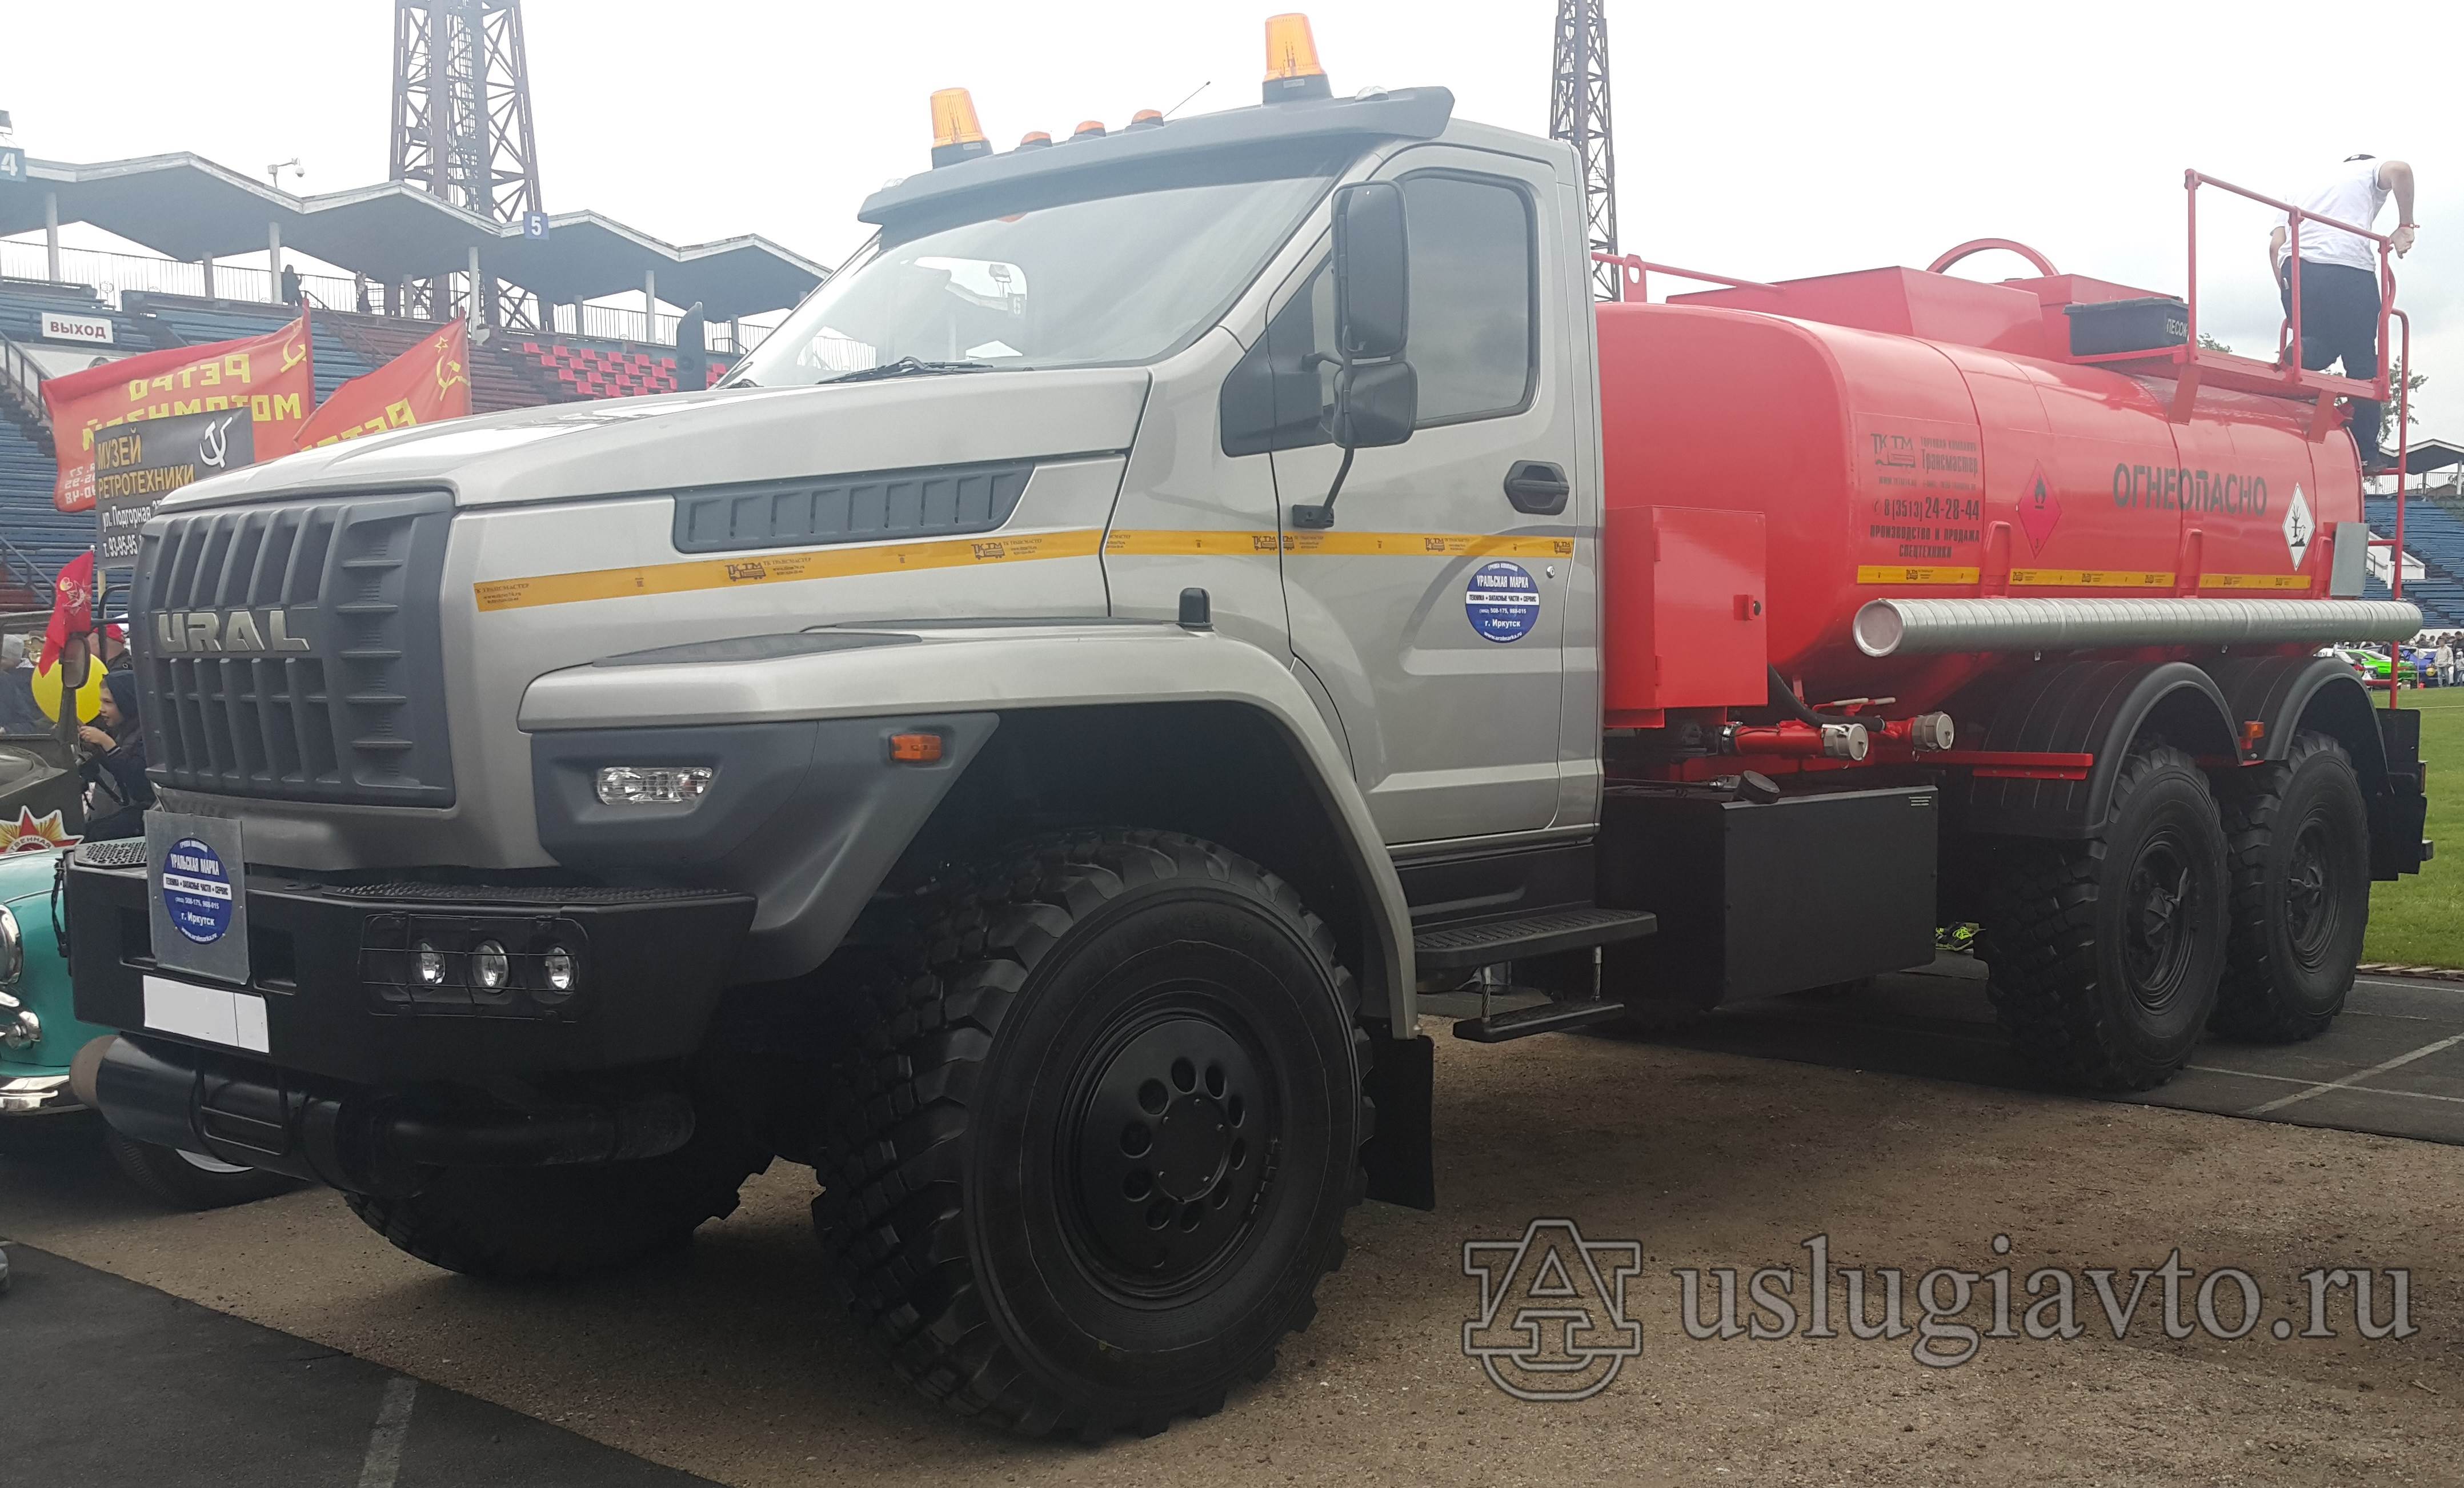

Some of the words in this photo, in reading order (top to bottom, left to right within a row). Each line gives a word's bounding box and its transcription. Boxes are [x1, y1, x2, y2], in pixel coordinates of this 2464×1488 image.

[1, 153, 18, 176] 4
[531, 215, 542, 236] 5
[50, 321, 106, 339] ВЫХОД
[98, 427, 142, 471] МУЗЕЙ
[98, 464, 195, 500] РЕТРОТЕХНИКИ
[2113, 463, 2267, 517] ОГНЕОПАСНО
[112, 506, 151, 528] Подгорная
[1925, 496, 1980, 521] 24-28-44
[1870, 524, 1931, 541] ПРОИЗВОДСТВО
[1935, 528, 1940, 540] И
[1944, 529, 1980, 543] ПРОДАЖА
[109, 534, 138, 557] 93-95-95
[1899, 544, 1952, 559] СПЕЦТЕХНИКИ
[1477, 575, 1508, 588] УРАЛЬСКАЯ
[1509, 576, 1529, 588] МАРКА
[158, 611, 311, 652] URAL
[1492, 619, 1521, 629] Иркутск
[200, 858, 220, 876] МАРКА
[181, 912, 187, 921] г.
[187, 912, 215, 927] Иркутск
